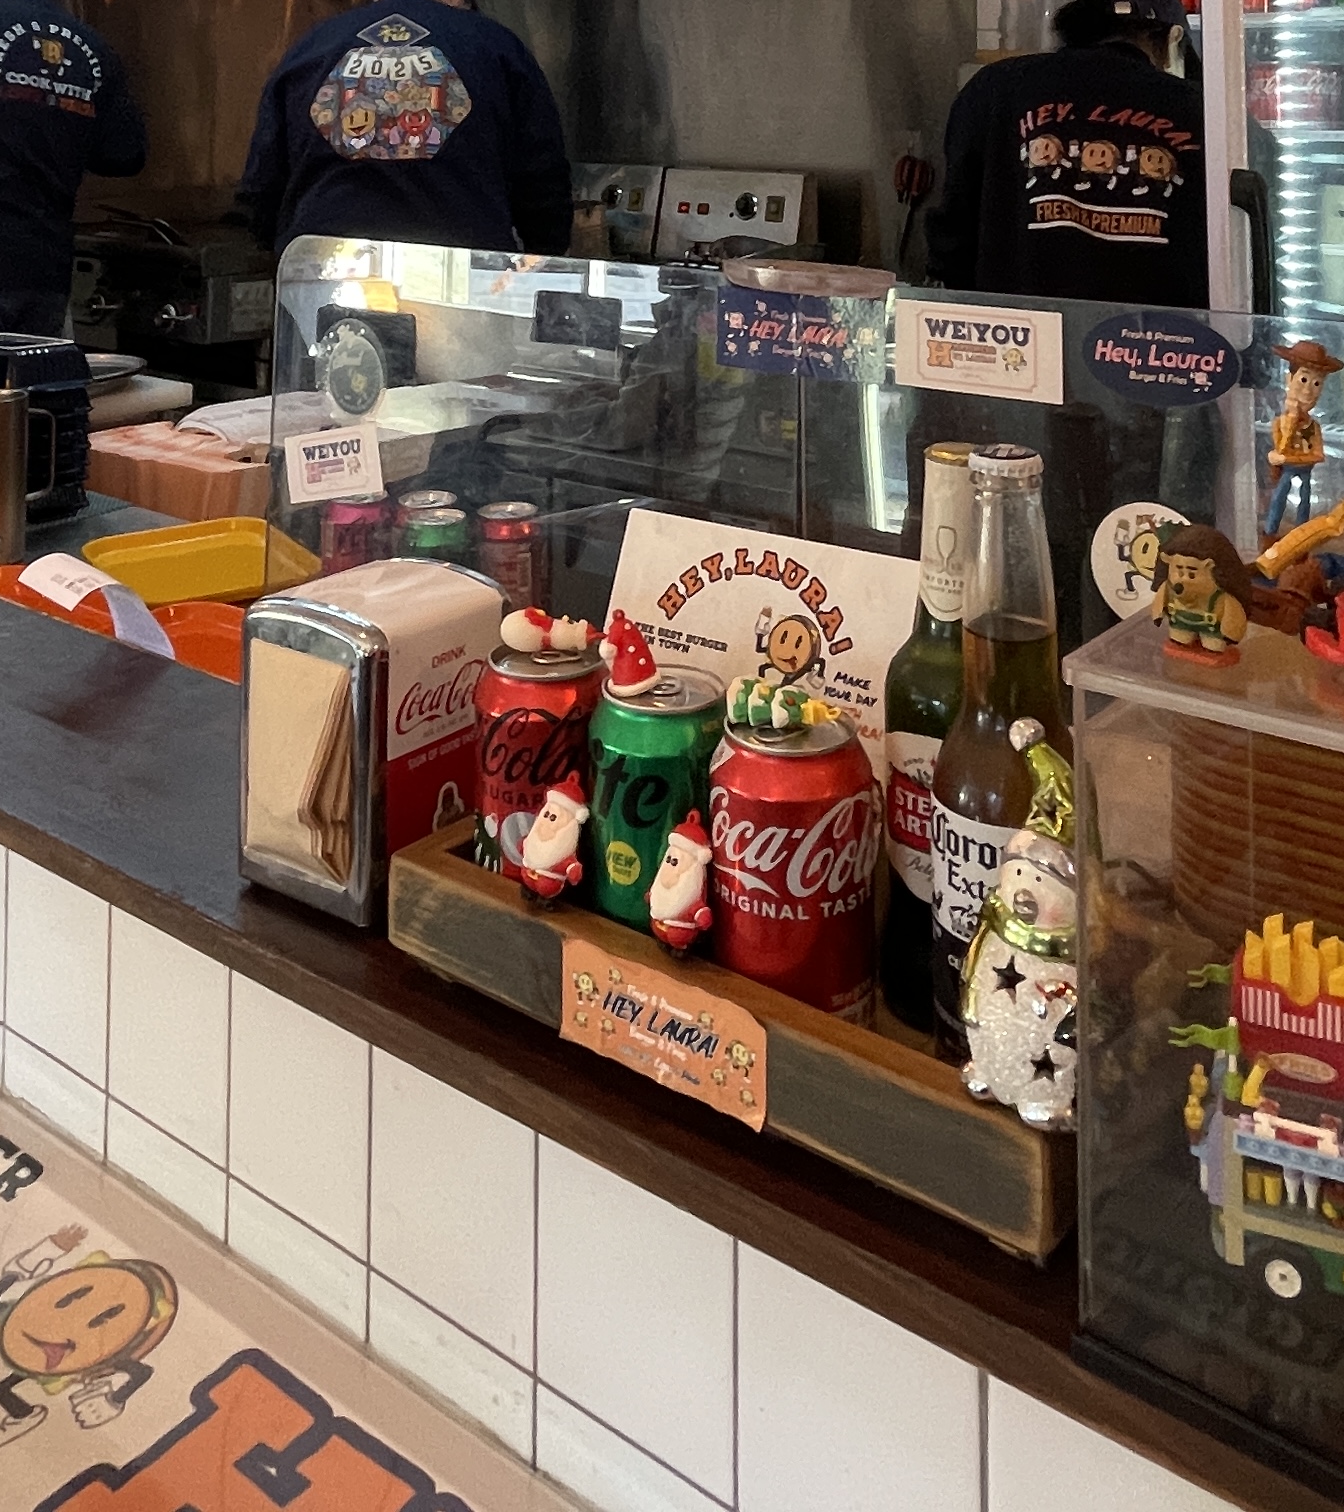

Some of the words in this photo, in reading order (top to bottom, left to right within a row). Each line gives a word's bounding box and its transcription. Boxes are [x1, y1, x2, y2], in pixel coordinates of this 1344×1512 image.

[348, 53, 433, 79] 2025
[6, 71, 52, 89] COOK
[52, 81, 92, 101] WITH
[1035, 202, 1081, 224] FRESH
[1090, 213, 1162, 235] PREMIUM
[1094, 339, 1143, 368] Hey,
[1147, 343, 1226, 373] Laura!
[657, 626, 684, 641] BEST
[686, 633, 729, 653] BURGER
[657, 638, 691, 654] TOWN
[432, 645, 468, 669] DRINK
[833, 671, 873, 691] MAKE
[823, 686, 853, 703] YOUR
[854, 692, 879, 709] DAY
[488, 785, 545, 808] UGAR
[714, 877, 810, 920] ORIGINAL
[646, 1010, 721, 1061] LAURA!
